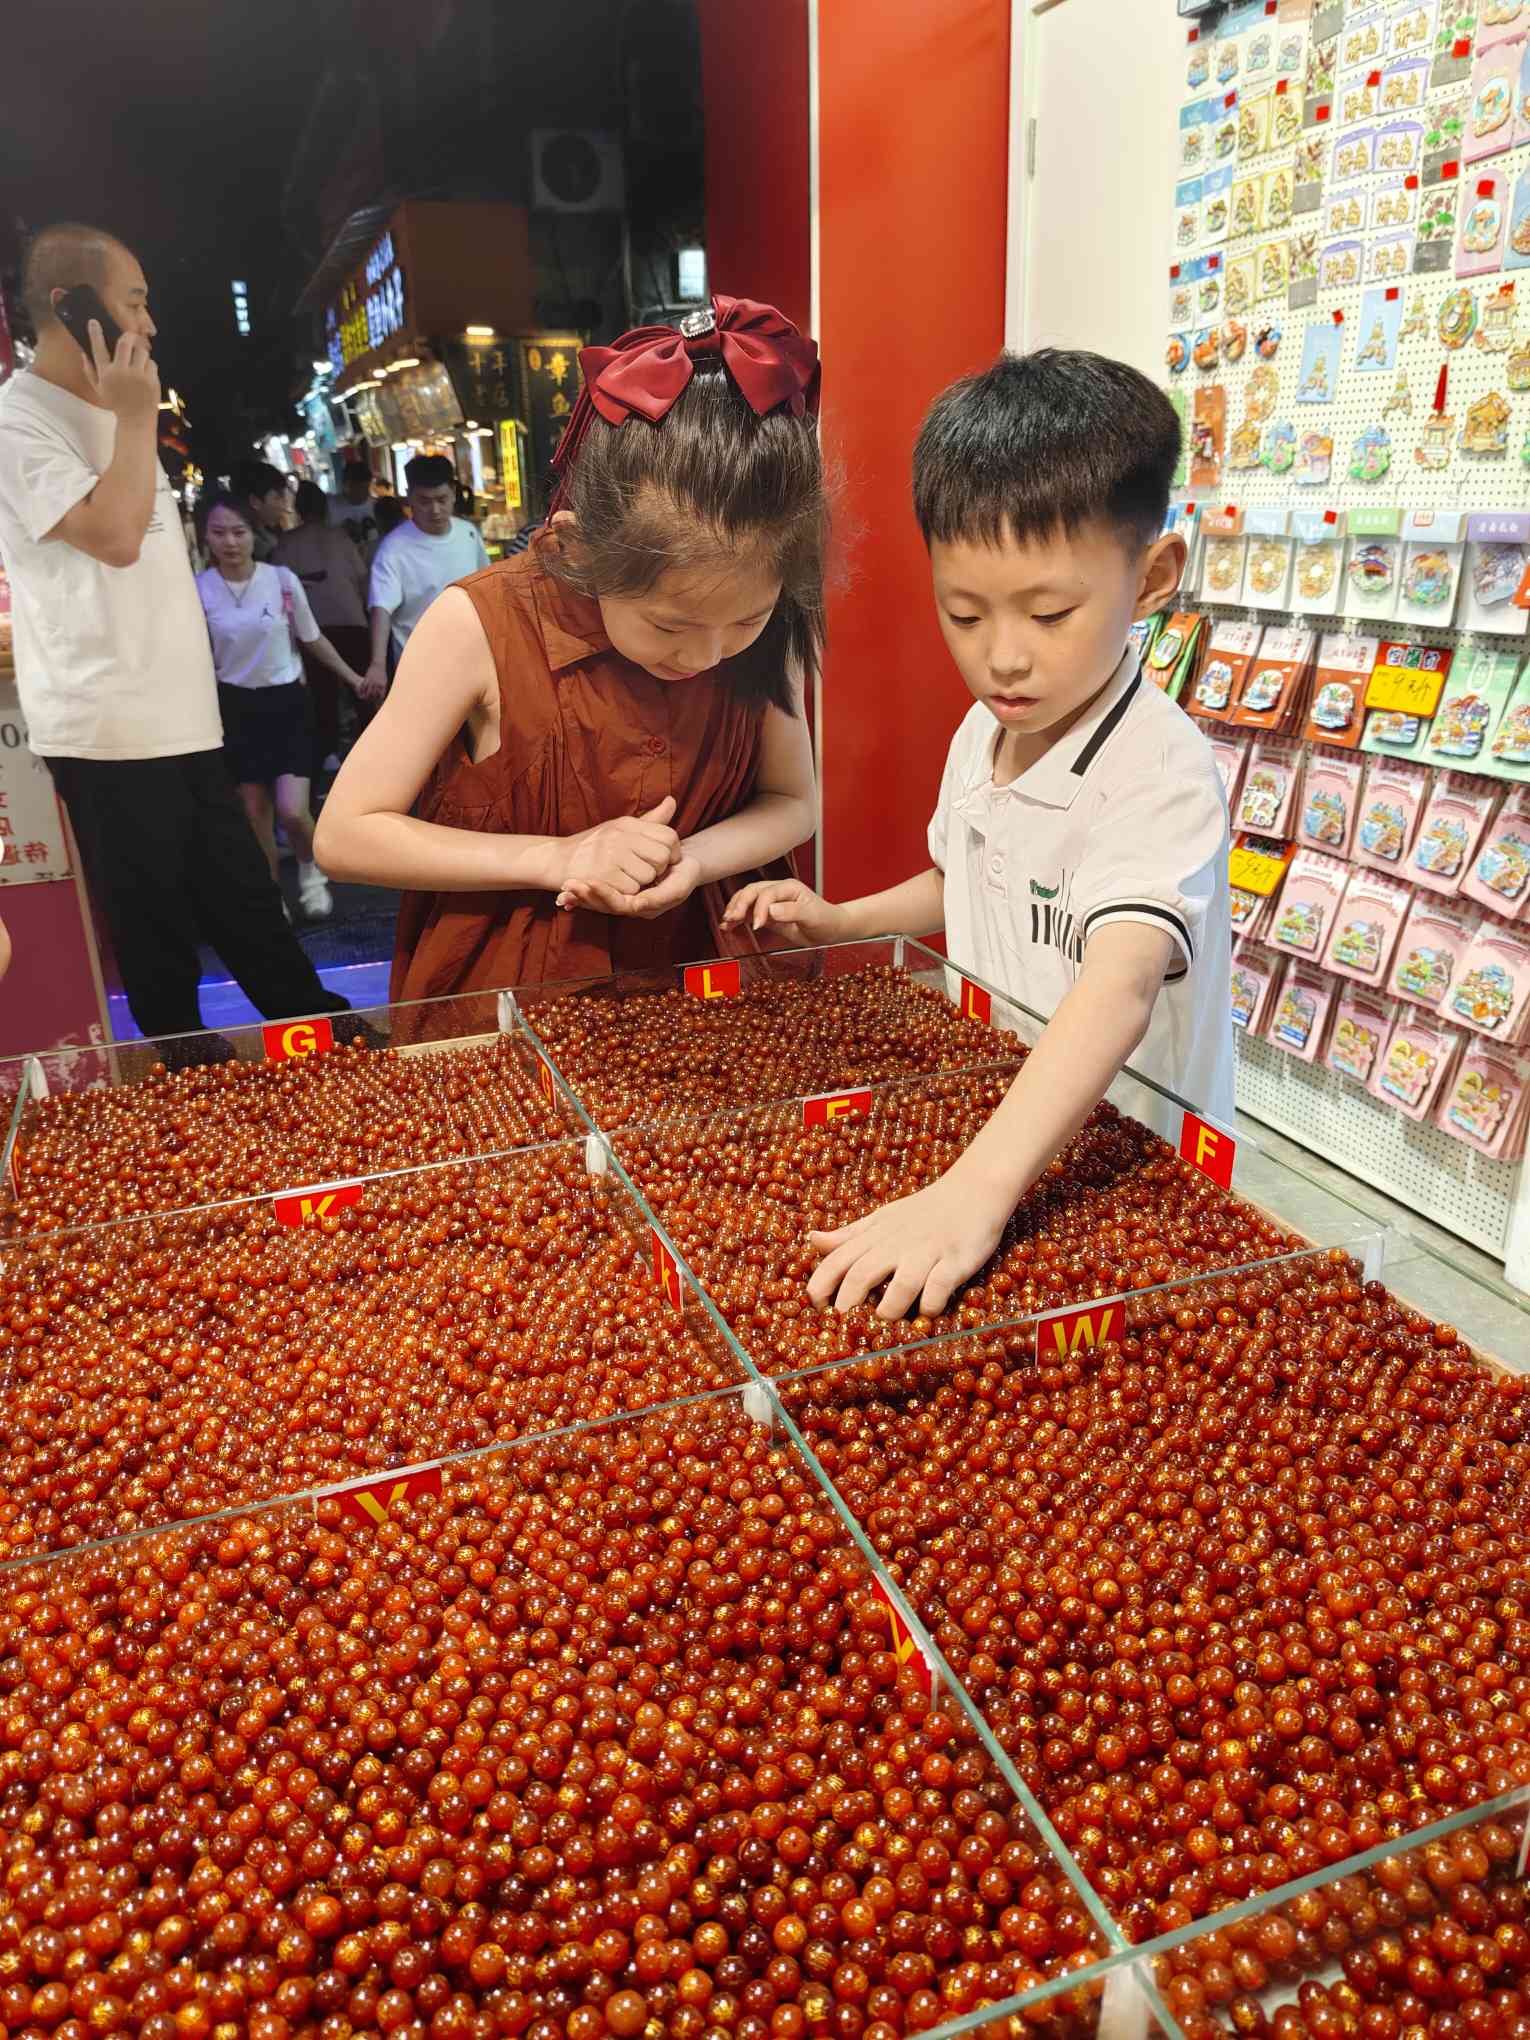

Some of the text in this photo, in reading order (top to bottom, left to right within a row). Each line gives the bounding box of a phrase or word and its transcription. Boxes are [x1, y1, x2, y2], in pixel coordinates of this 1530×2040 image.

[703, 969, 724, 999] L
[969, 985, 983, 1020] L
[281, 1025, 317, 1057] G
[1195, 1125, 1219, 1166] F
[300, 1194, 337, 1220] K
[1052, 1310, 1114, 1358] W
